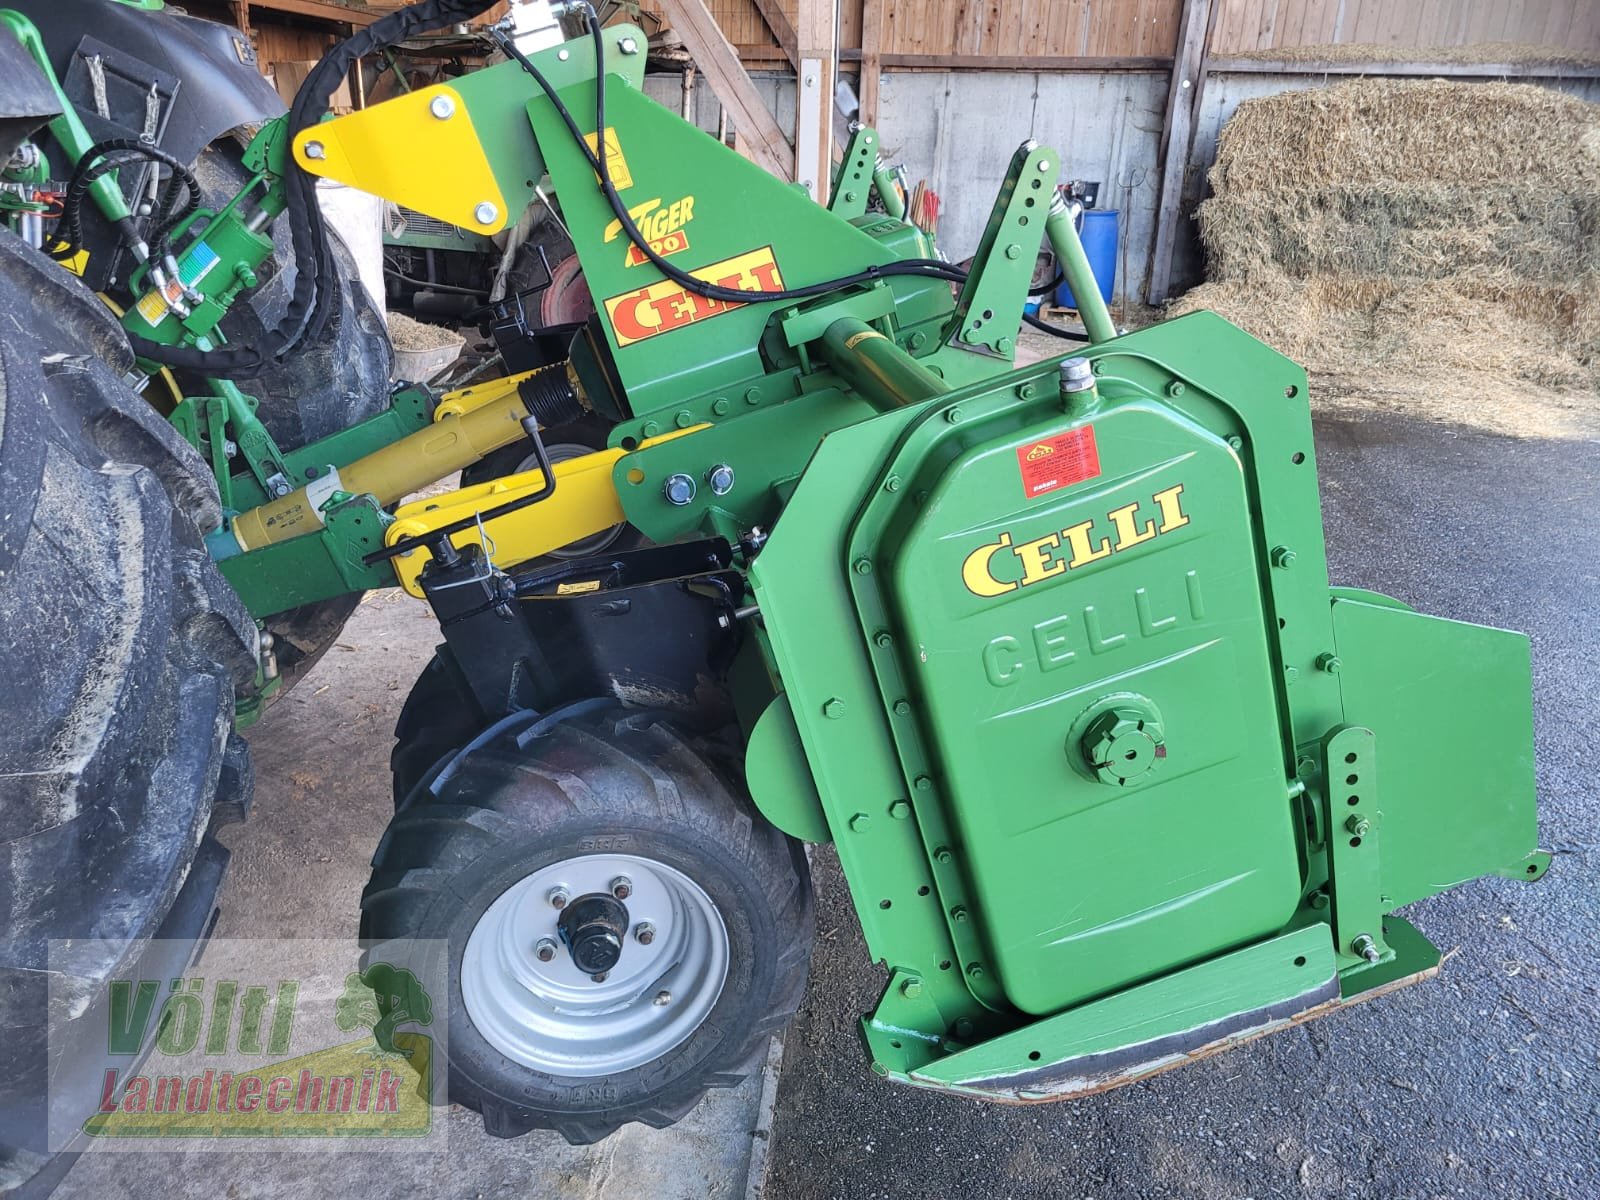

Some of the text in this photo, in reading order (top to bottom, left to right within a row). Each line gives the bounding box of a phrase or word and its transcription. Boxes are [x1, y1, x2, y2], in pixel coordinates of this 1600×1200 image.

[604, 195, 695, 268] TIGER
[961, 483, 1190, 597] CELLI
[982, 570, 1204, 687] CELLI
